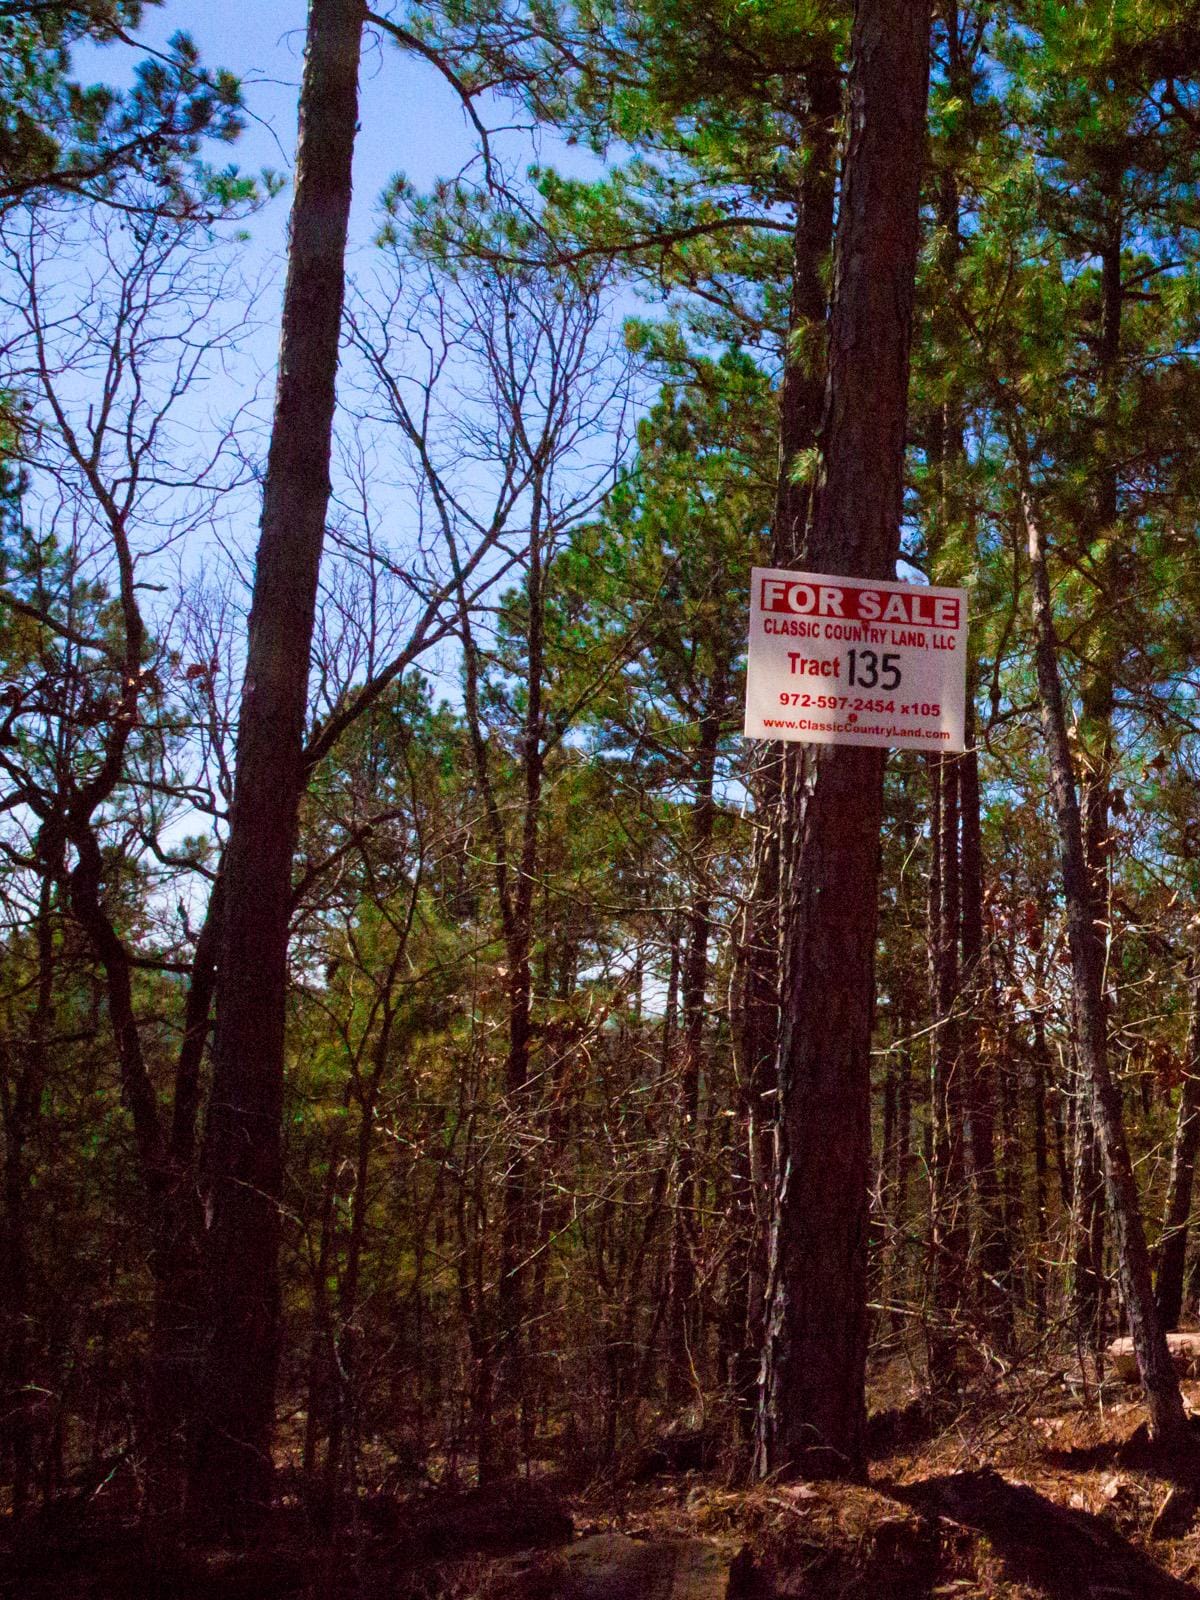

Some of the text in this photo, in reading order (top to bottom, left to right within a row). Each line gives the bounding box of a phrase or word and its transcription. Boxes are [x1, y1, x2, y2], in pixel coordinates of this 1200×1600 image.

[764, 582, 957, 628] FOR SALE
[764, 618, 956, 651] CLASSIC COUNTRY LAND, LLC
[788, 649, 902, 691] Tract 135
[779, 692, 941, 717] 972-597-2454 x105
[763, 718, 951, 740] www.ClassicCountryLand.com
